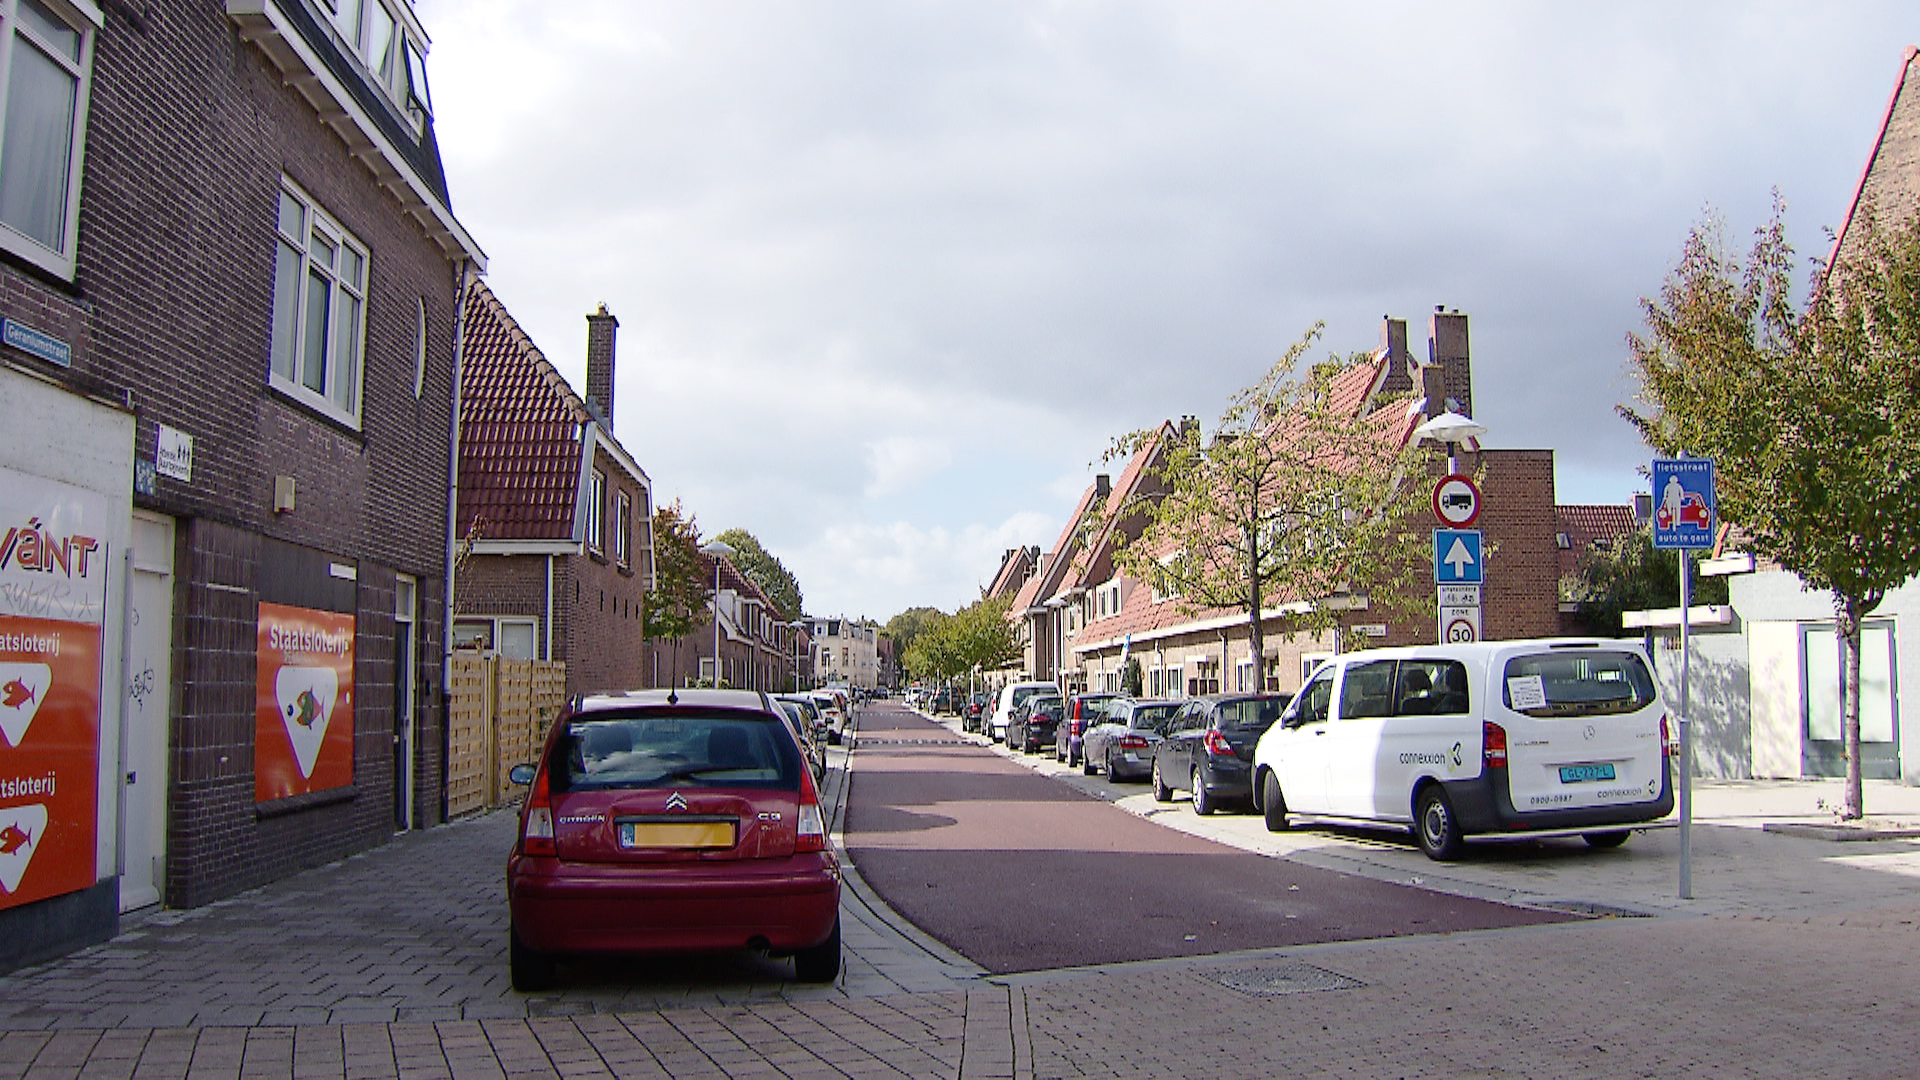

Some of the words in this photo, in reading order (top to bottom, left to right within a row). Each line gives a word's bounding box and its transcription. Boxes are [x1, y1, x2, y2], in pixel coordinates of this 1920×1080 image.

[8, 324, 68, 361] Geraniumstraat
[1680, 534, 1688, 542] te
[1690, 534, 1709, 544] gast
[270, 623, 346, 659] Staatsloterij
[1452, 629, 1471, 642] 30
[1399, 753, 1446, 764] connexxion
[1597, 787, 1642, 798] connexxion
